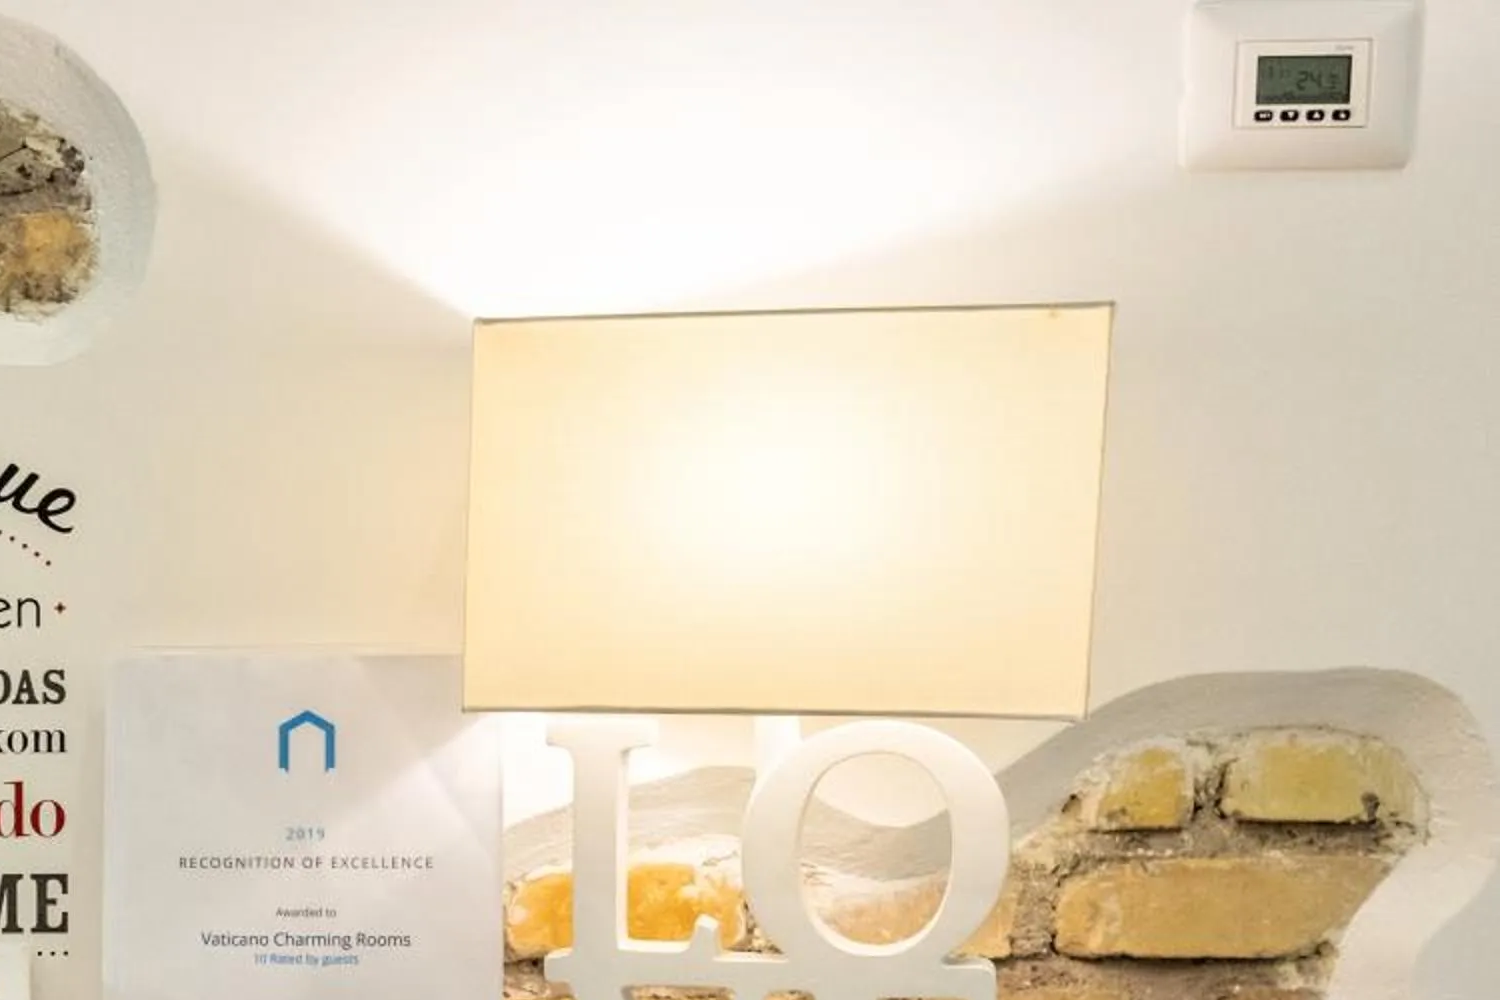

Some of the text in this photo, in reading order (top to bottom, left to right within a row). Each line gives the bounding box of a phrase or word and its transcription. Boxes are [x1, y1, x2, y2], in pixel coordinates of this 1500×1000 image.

[285, 828, 326, 841] 2019
[179, 856, 434, 870] RECOGNITION OF EXCELLENCE
[326, 908, 337, 918] to
[201, 931, 412, 951] Vaticano Charming Rooms
